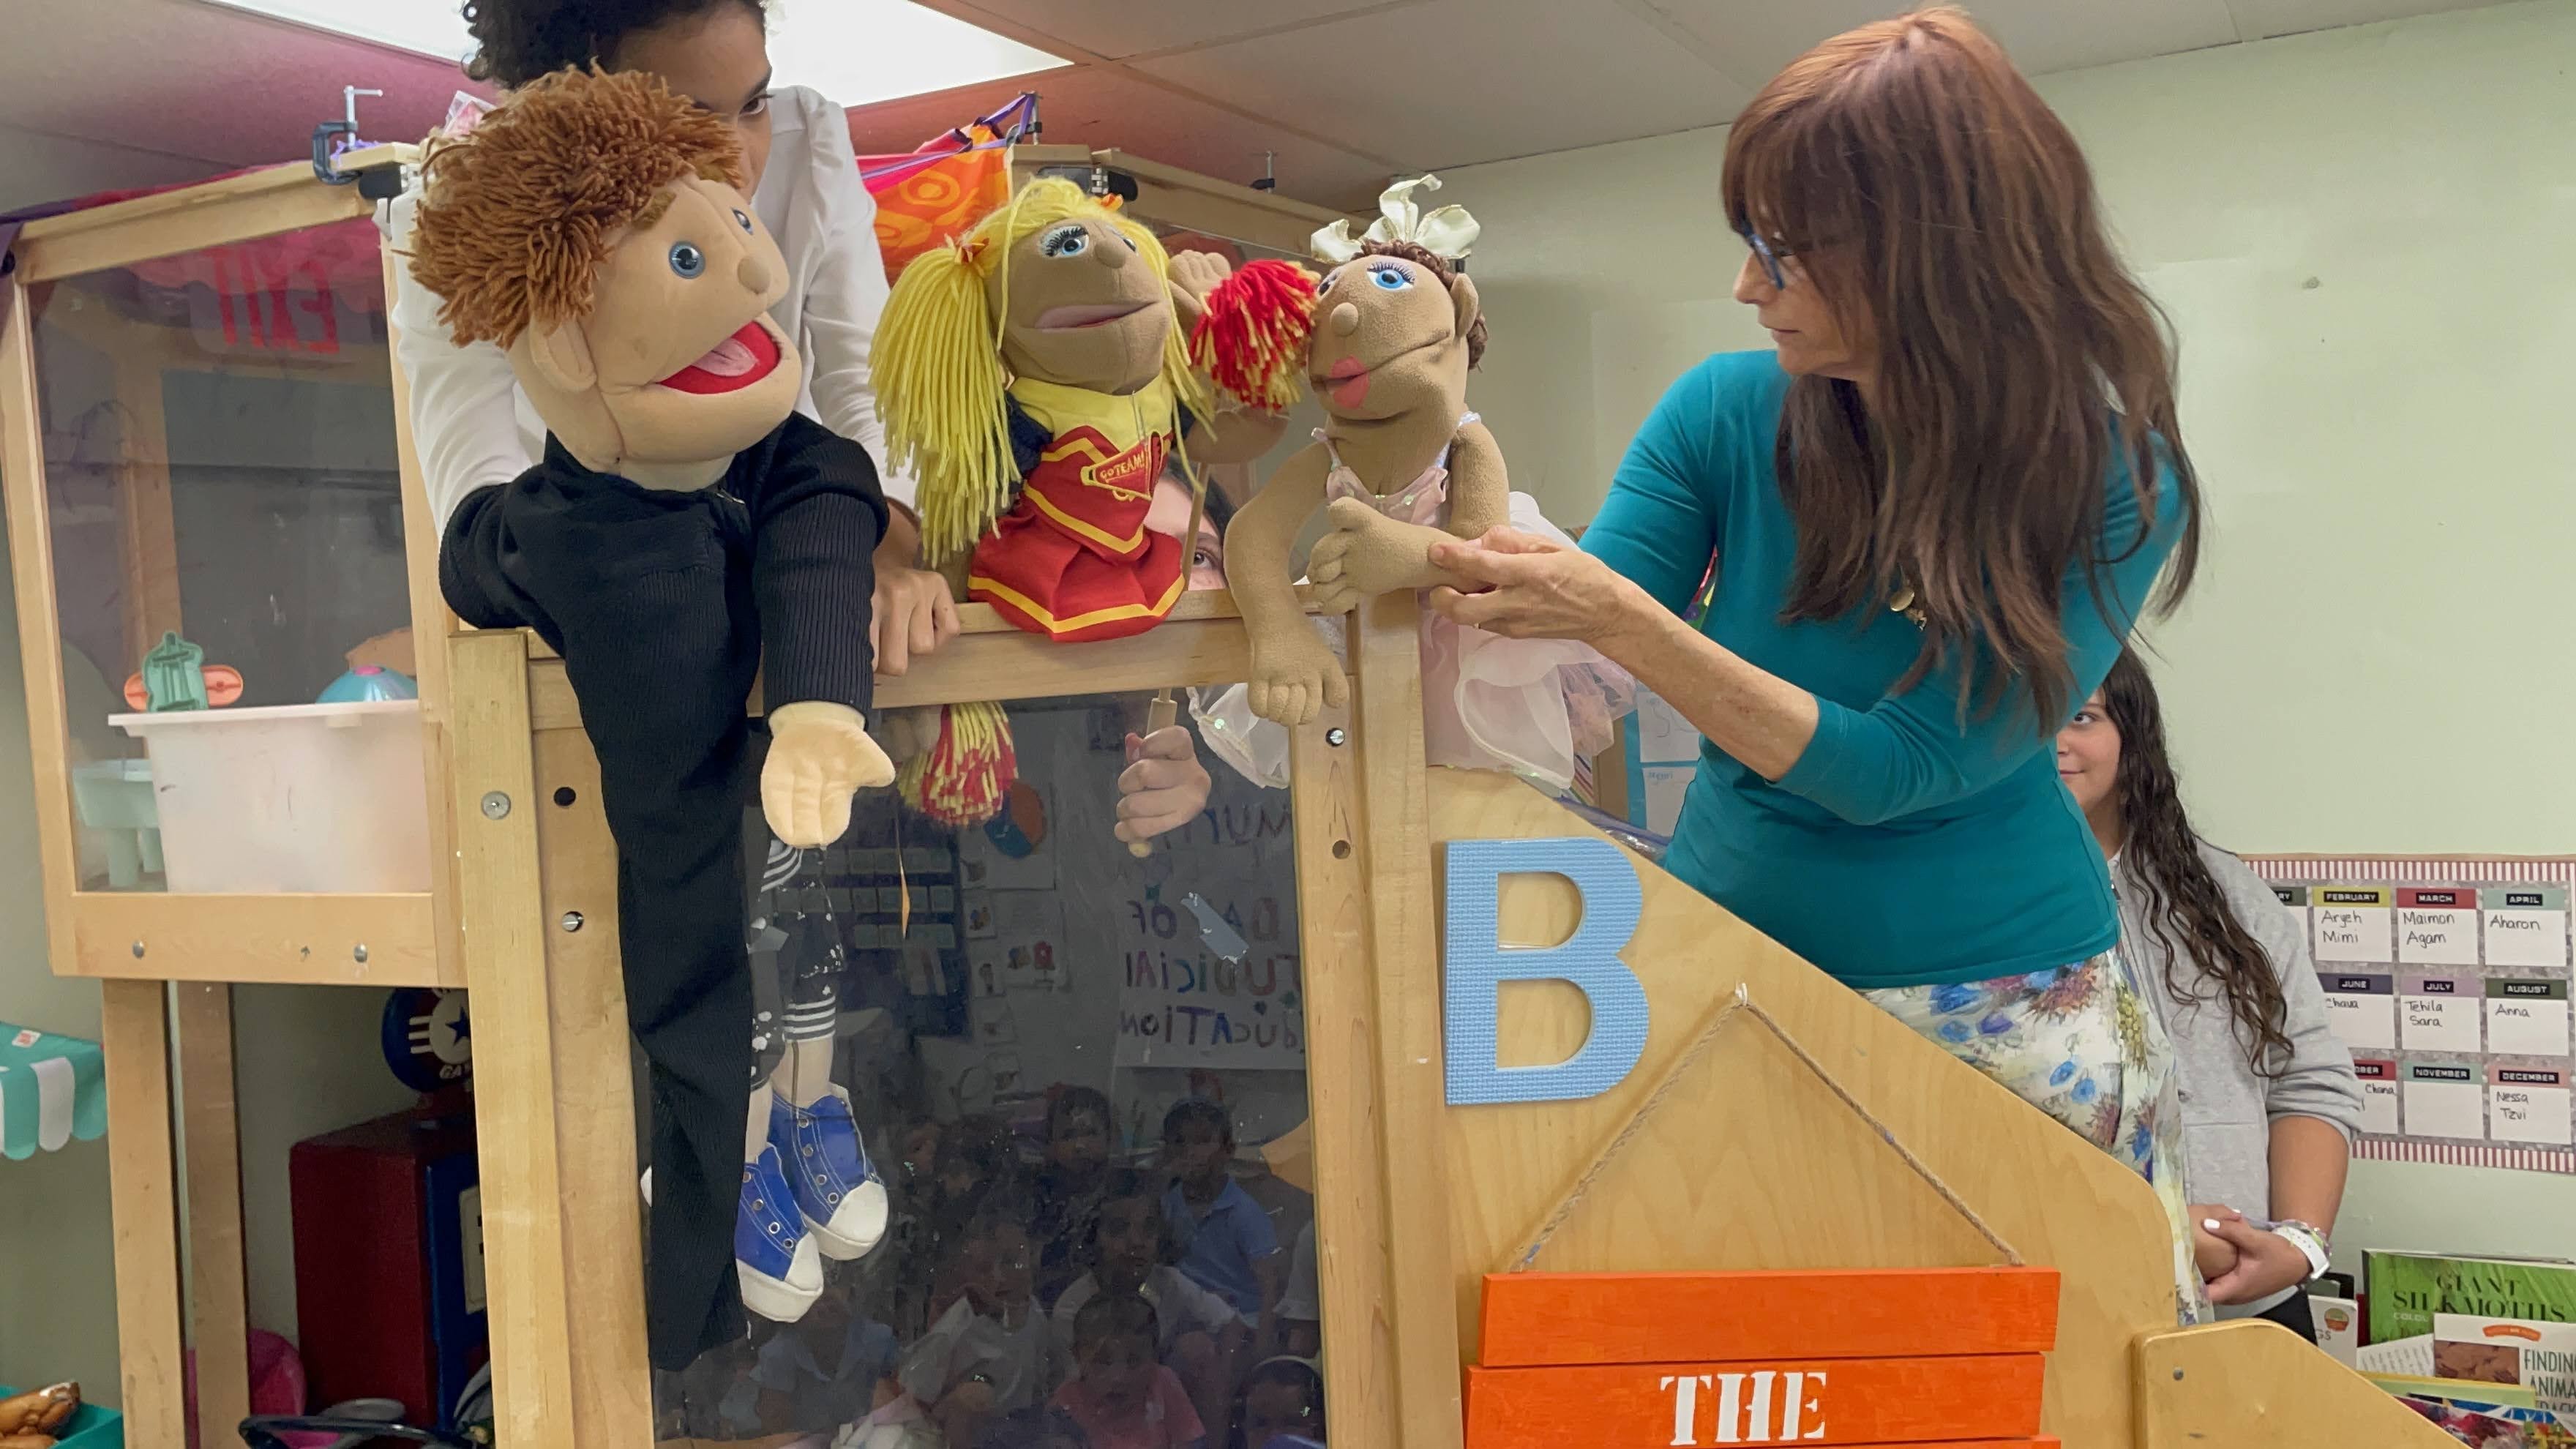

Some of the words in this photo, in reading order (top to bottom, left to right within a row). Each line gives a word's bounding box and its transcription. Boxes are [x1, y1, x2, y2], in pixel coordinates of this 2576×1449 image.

[1100, 469, 1115, 479] GO
[2326, 893, 2377, 902] FEBRUARY
[2418, 894, 2453, 903] MARCH
[2509, 896, 2539, 904] APRIL
[2321, 910, 2362, 928] Aryeh
[2403, 912, 2455, 925] Maimon
[2490, 915, 2540, 931] Aharon
[2322, 930, 2359, 943] Mimi
[2406, 930, 2446, 948] Agam
[1446, 837, 1650, 1106] B
[2341, 980, 2367, 989] JUNE
[2506, 985, 2547, 994] AUGUST
[2405, 1000, 2443, 1013] Tehila
[2495, 1003, 2530, 1018] Anna
[2409, 1015, 2442, 1027] Sara
[2354, 1066, 2379, 1074] OBER
[2415, 1068, 2468, 1079] NOVEMBER
[2501, 1072, 2556, 1082] DECEMBER
[2496, 1091, 2529, 1104] Nessa
[2500, 1107, 2527, 1120] Tzvi
[2436, 1276, 2520, 1296] GIANT
[2393, 1291, 2566, 1322] SILKMOTHS
[2524, 1349, 2576, 1374] FINDIN
[1660, 1371, 1827, 1447] THE
